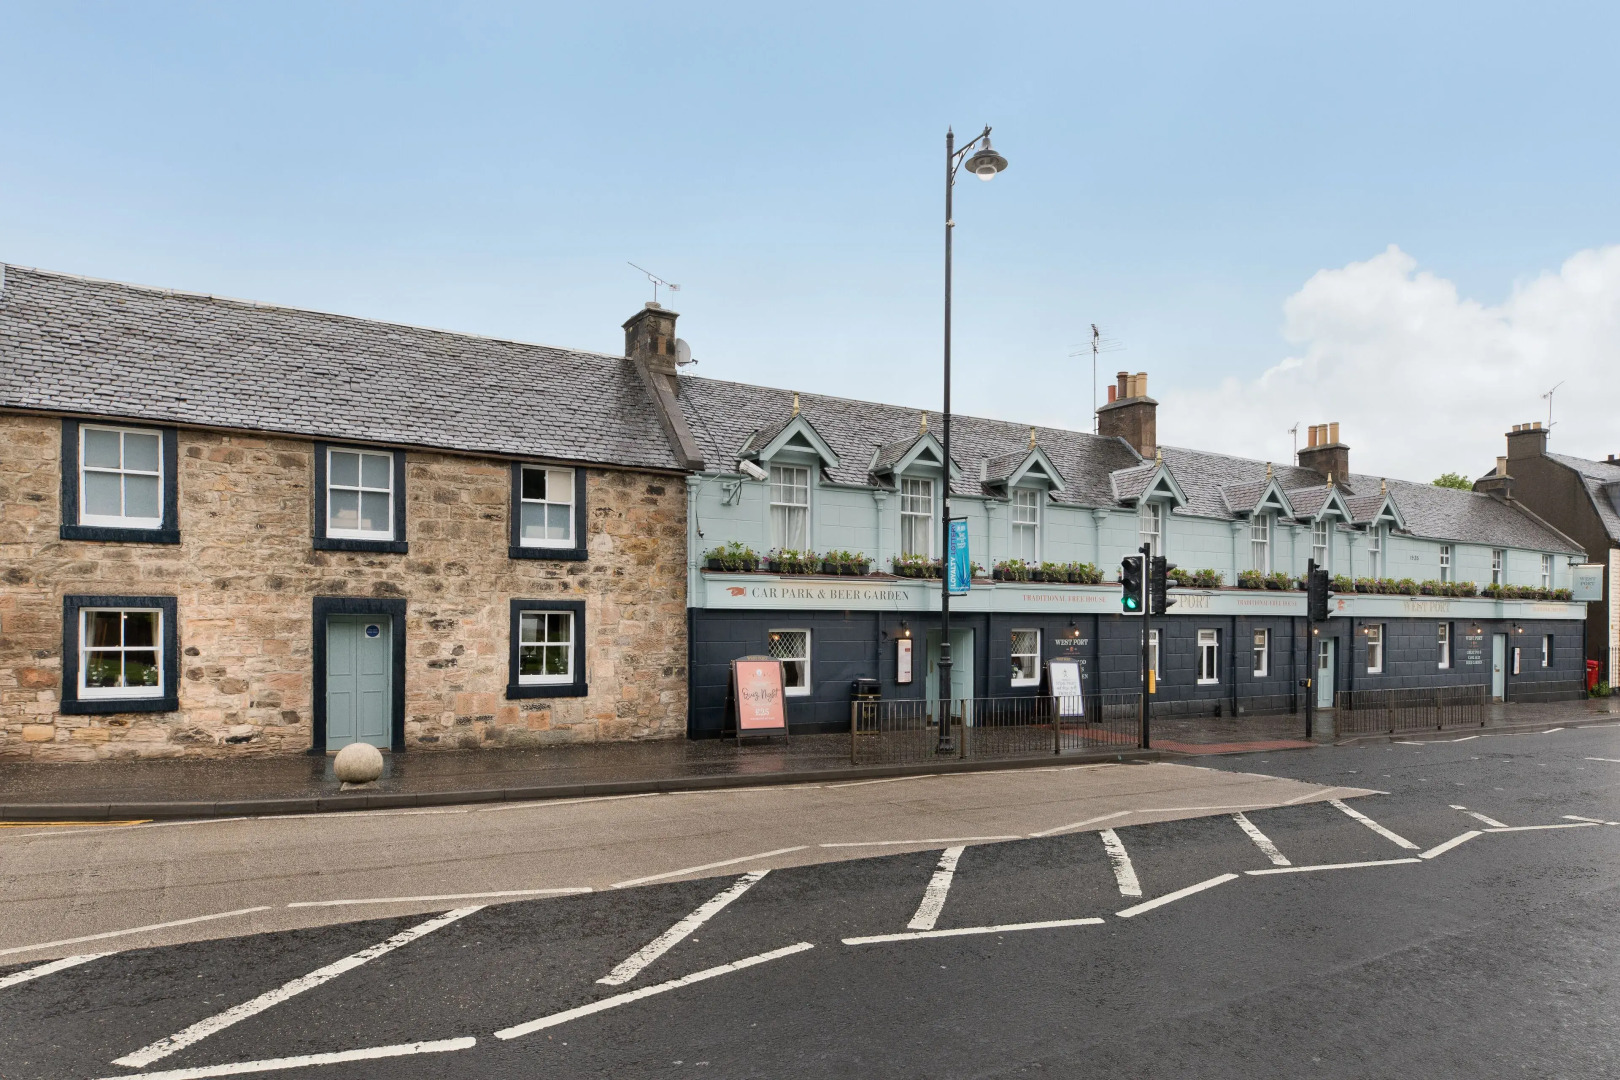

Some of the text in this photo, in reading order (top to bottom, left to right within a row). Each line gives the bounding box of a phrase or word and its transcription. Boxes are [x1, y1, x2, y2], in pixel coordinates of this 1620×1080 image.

[752, 587, 909, 600] CAR PARK & BEER GARDEN
[1180, 595, 1210, 608] PORT
[1403, 600, 1450, 612] WEST PORT
[742, 688, 781, 702] Quiz Night
